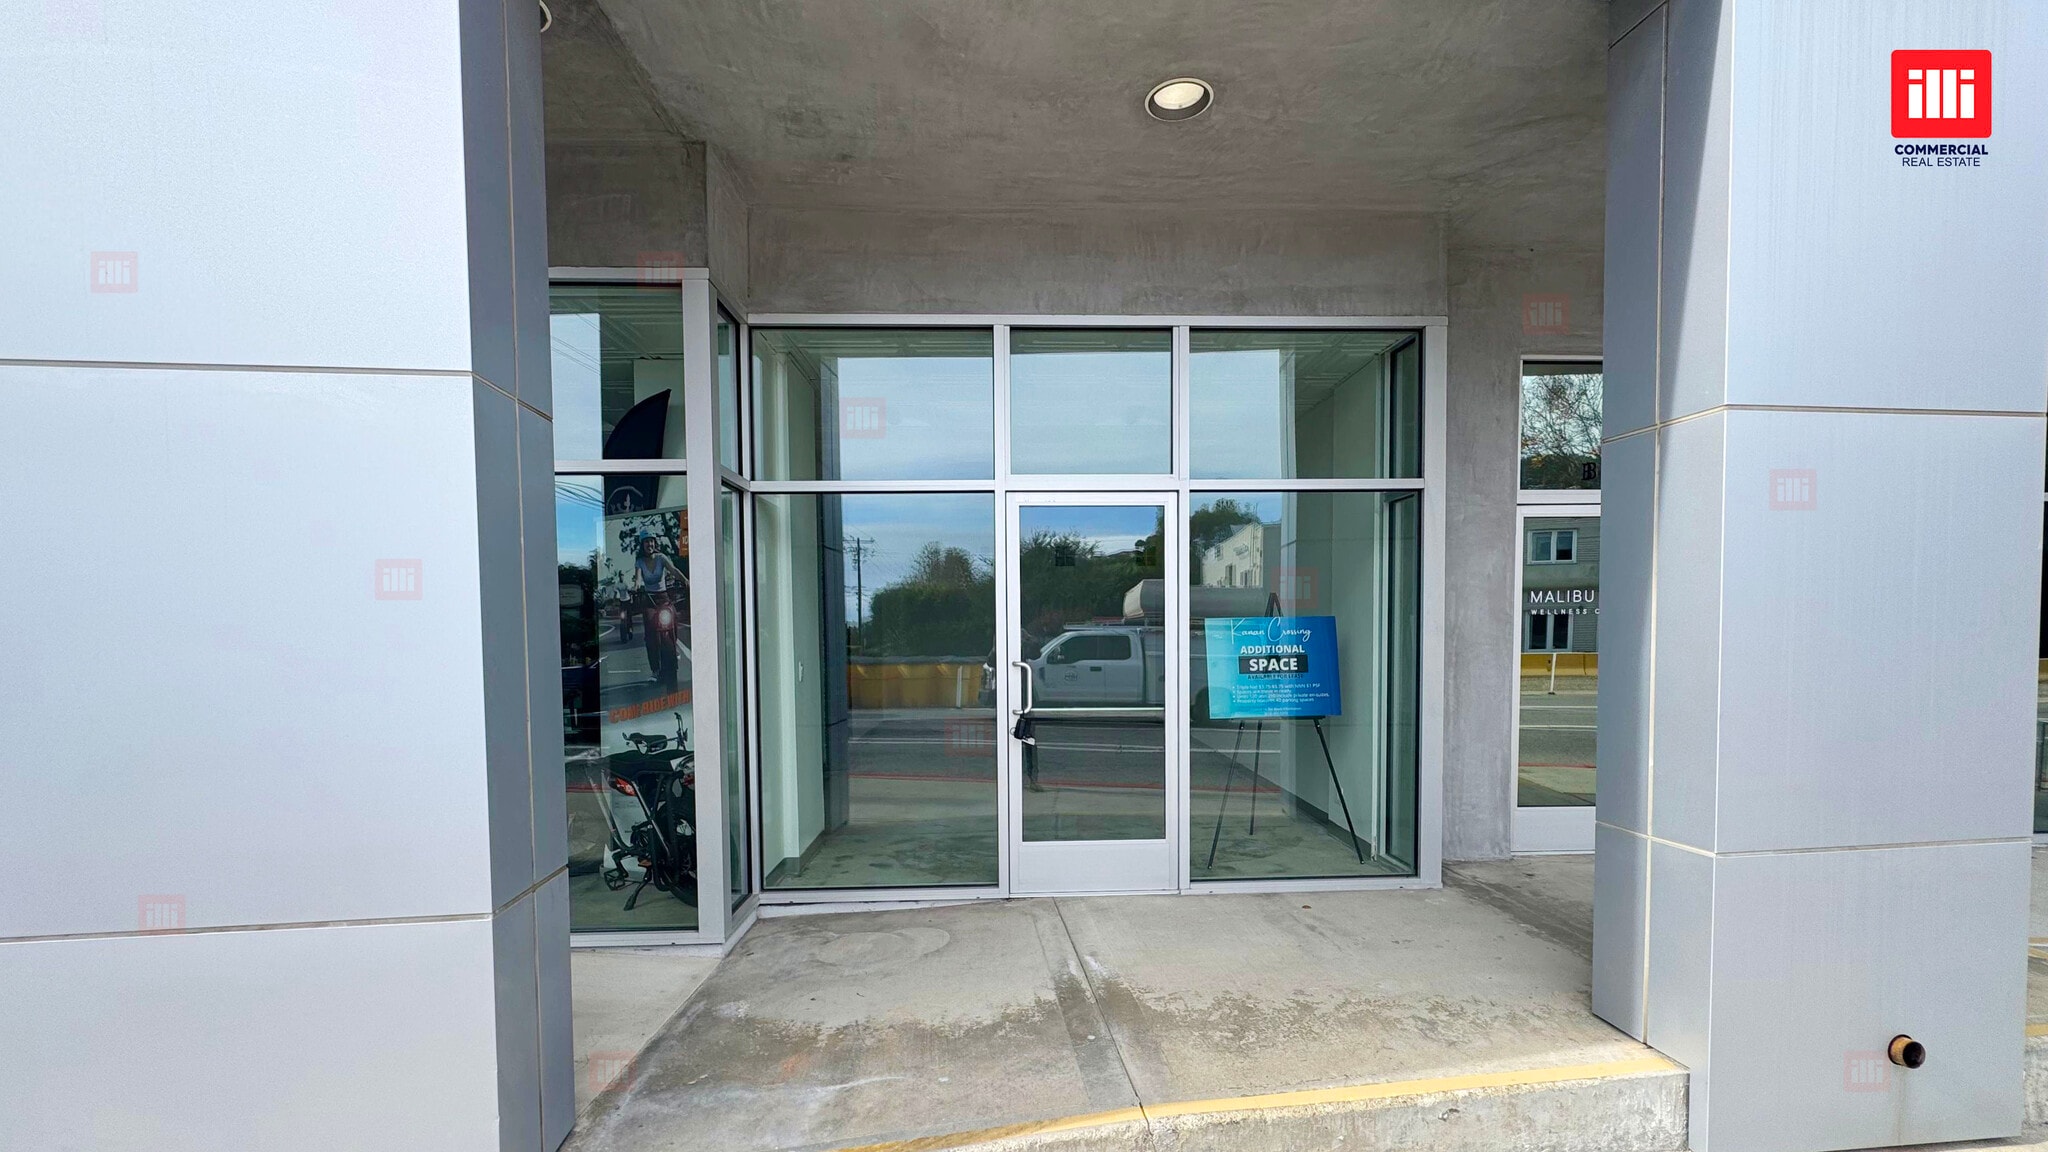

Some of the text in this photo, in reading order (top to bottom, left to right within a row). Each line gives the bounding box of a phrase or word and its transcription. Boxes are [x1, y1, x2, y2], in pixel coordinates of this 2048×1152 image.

[1530, 590, 1595, 603] MALIBU
[1531, 608, 1588, 616] WELLNESS
[1230, 616, 1312, 644] Kanan Crossing
[1240, 644, 1305, 655] ADDITIONAL
[1249, 658, 1298, 672] SPACE
[641, 696, 667, 716] RIDE
[667, 688, 692, 709] WITH
